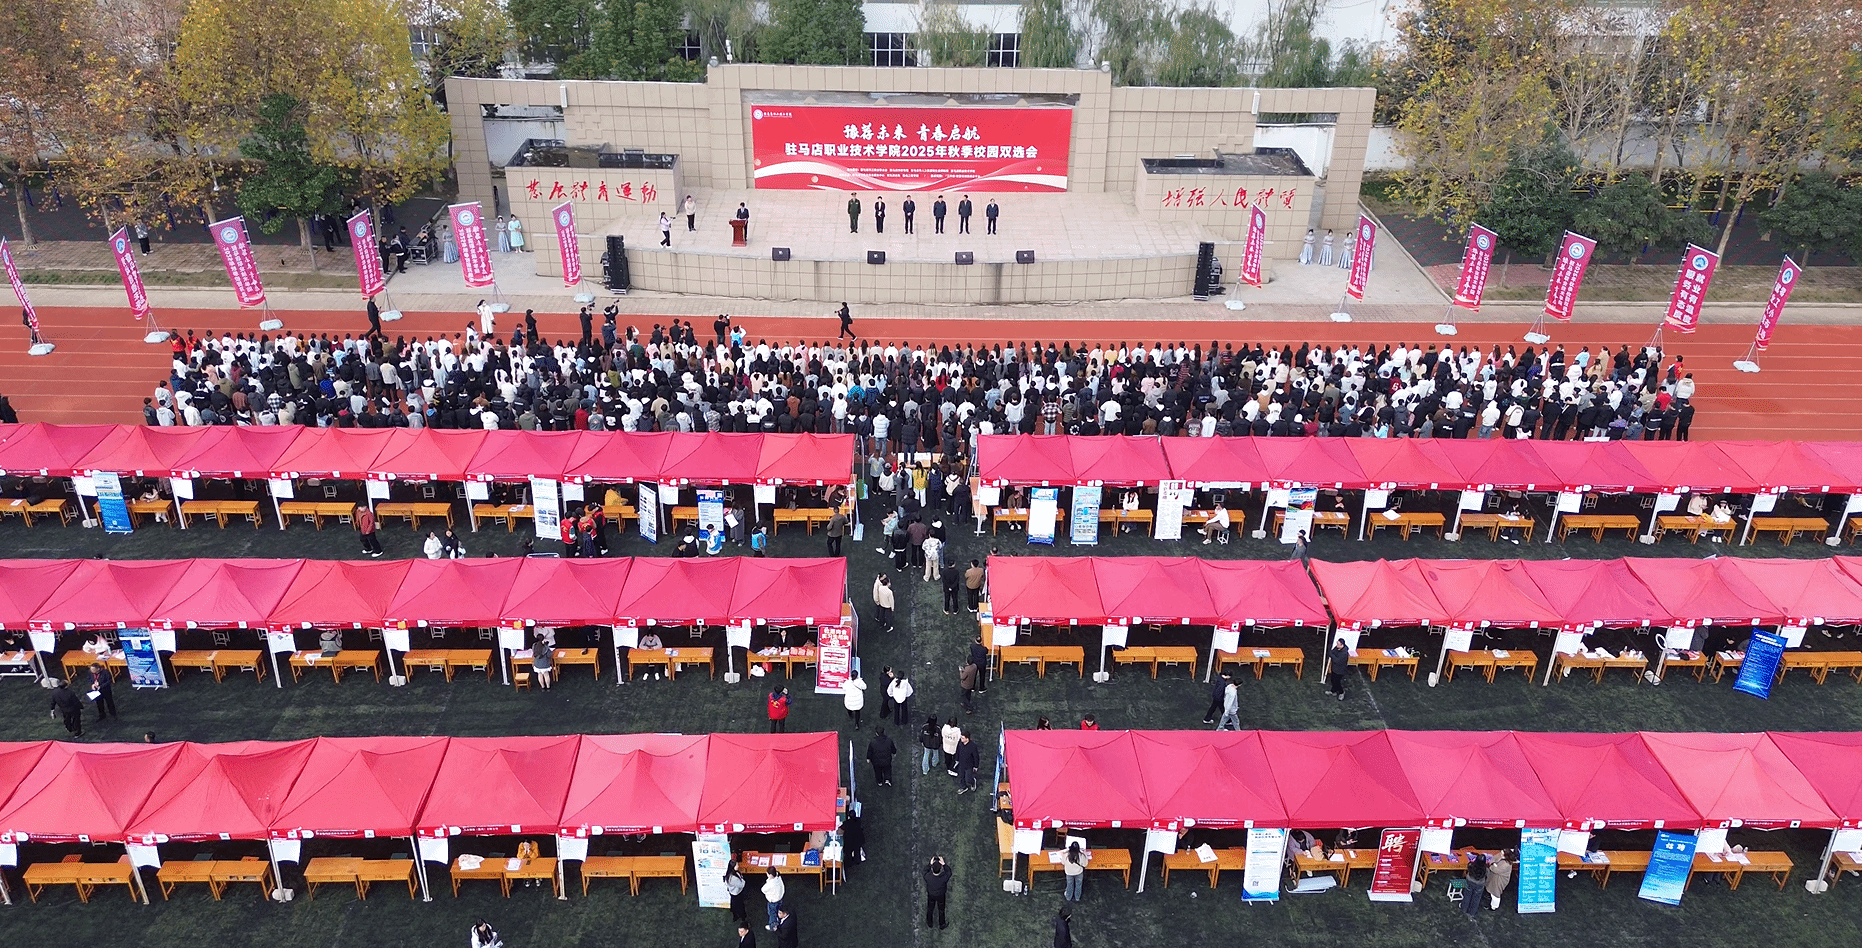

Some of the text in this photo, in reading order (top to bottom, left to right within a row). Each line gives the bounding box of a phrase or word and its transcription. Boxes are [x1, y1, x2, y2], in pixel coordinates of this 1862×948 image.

[843, 122, 981, 142] 豫荐未来 青春启航
[785, 142, 1038, 159] 驻马店职业技术学院2025年秋季校园双选会
[1381, 833, 1408, 853] 聘
